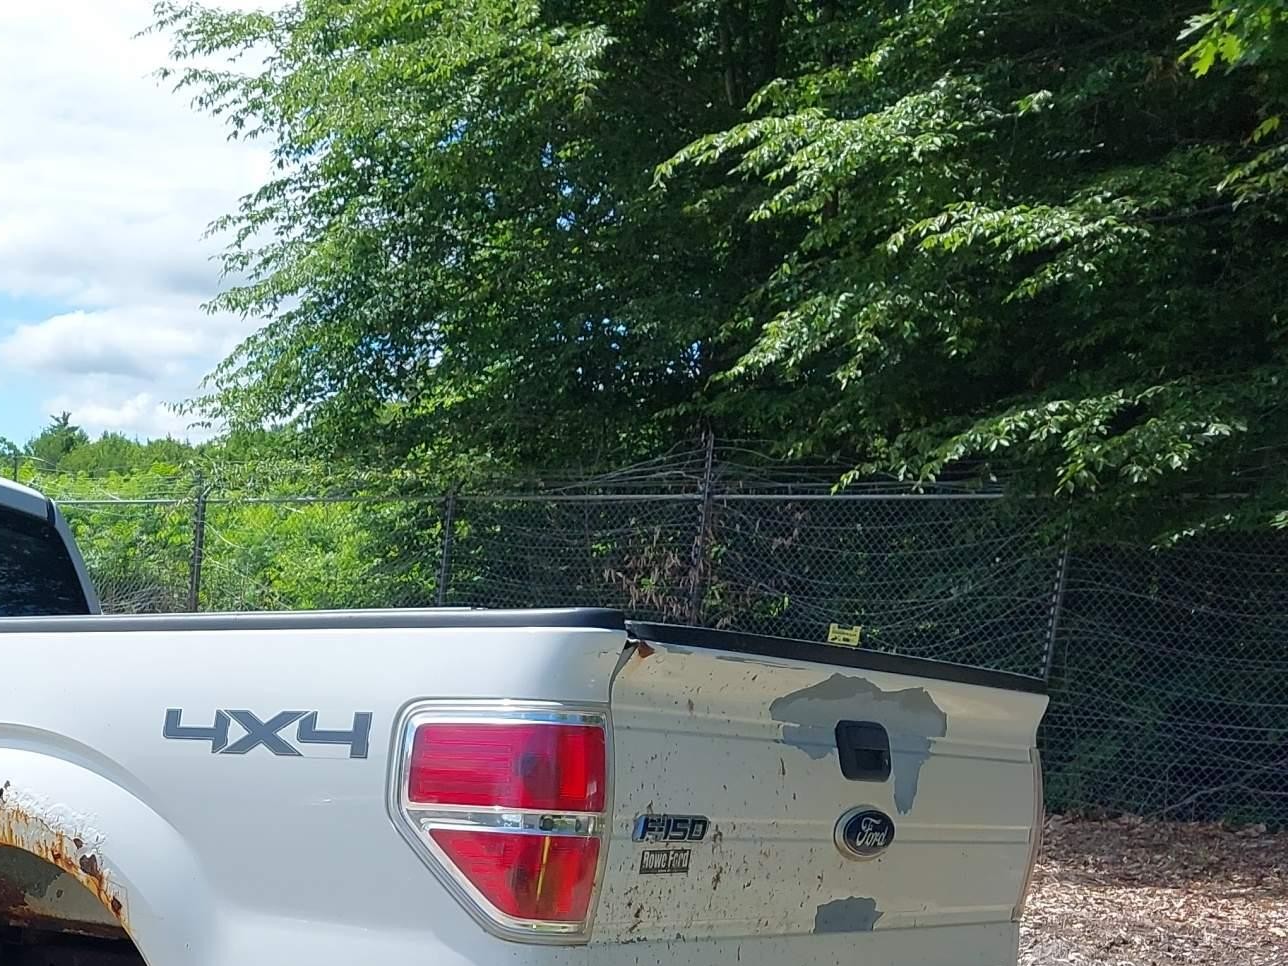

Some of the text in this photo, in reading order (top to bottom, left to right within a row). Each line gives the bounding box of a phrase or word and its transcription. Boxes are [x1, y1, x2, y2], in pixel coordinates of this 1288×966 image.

[856, 817, 888, 848] Ford
[642, 850, 689, 870] Rowe Ford
